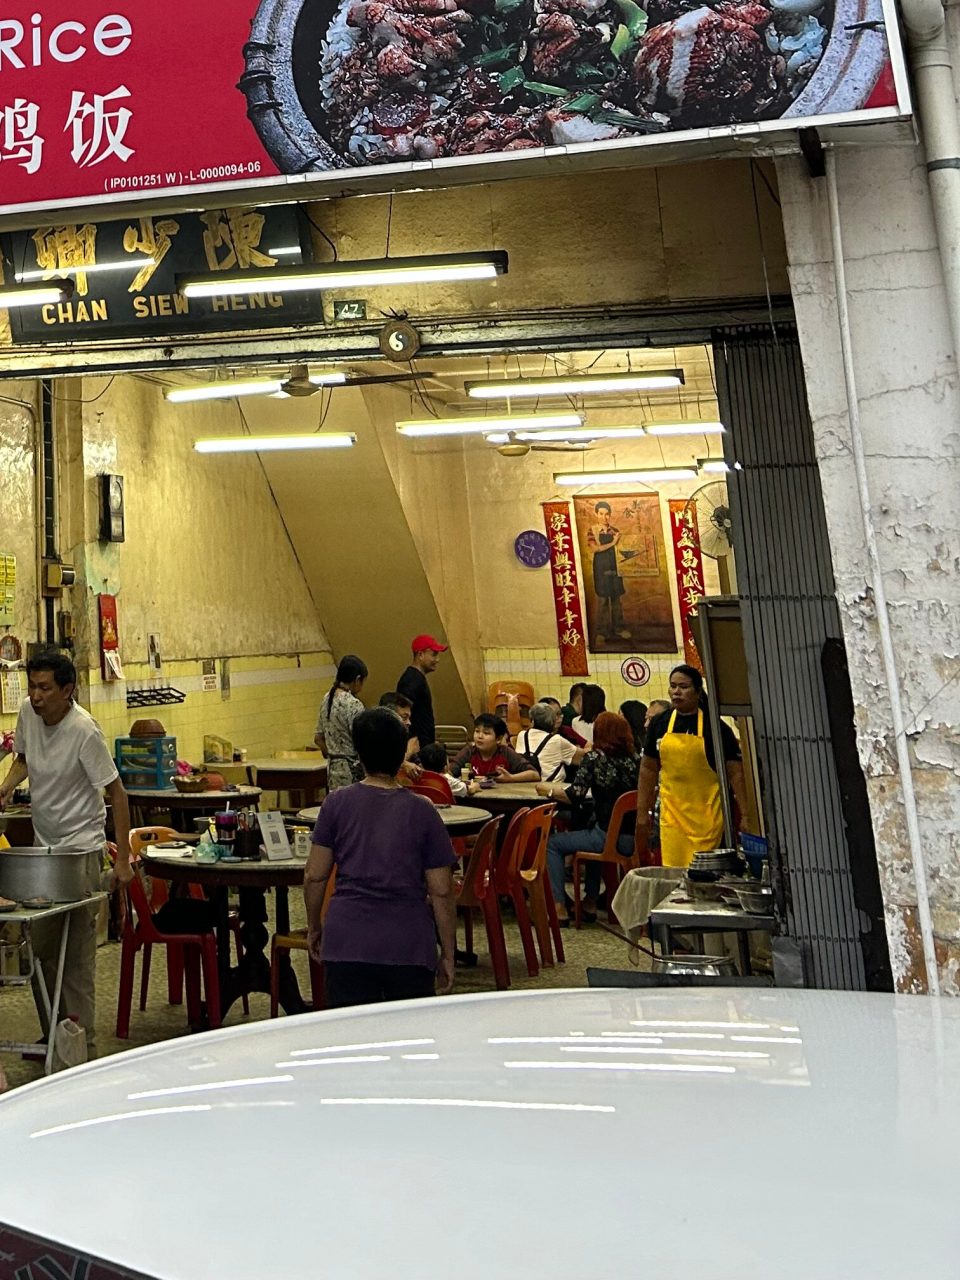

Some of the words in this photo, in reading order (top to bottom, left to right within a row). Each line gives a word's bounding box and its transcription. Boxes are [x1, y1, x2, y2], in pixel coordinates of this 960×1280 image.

[42, 300, 108, 325] CHAN
[133, 294, 190, 318] SIEW
[212, 292, 283, 312] HENG
